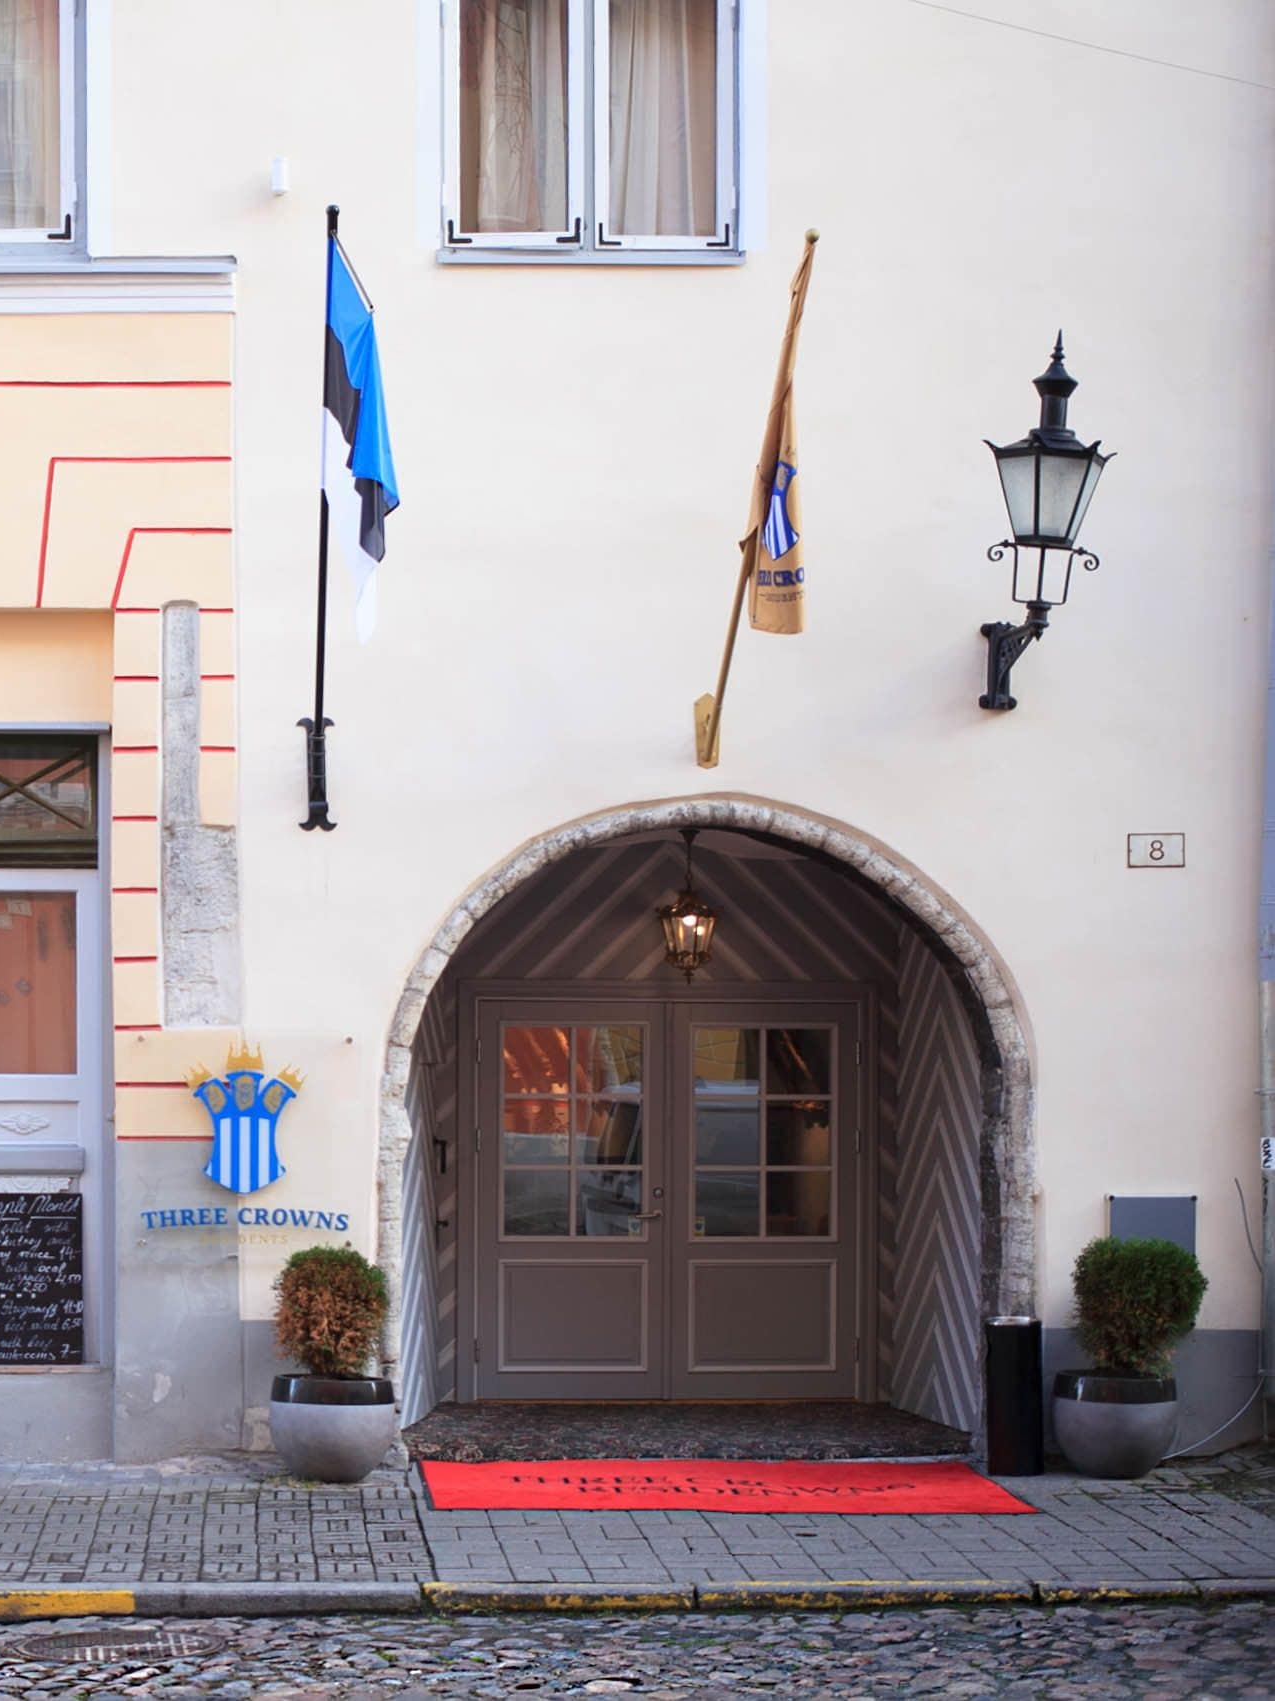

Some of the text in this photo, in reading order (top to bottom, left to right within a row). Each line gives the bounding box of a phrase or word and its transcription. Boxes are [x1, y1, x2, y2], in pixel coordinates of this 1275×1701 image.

[1149, 840, 1165, 861] 8
[141, 1207, 349, 1231] THREE CROWNS
